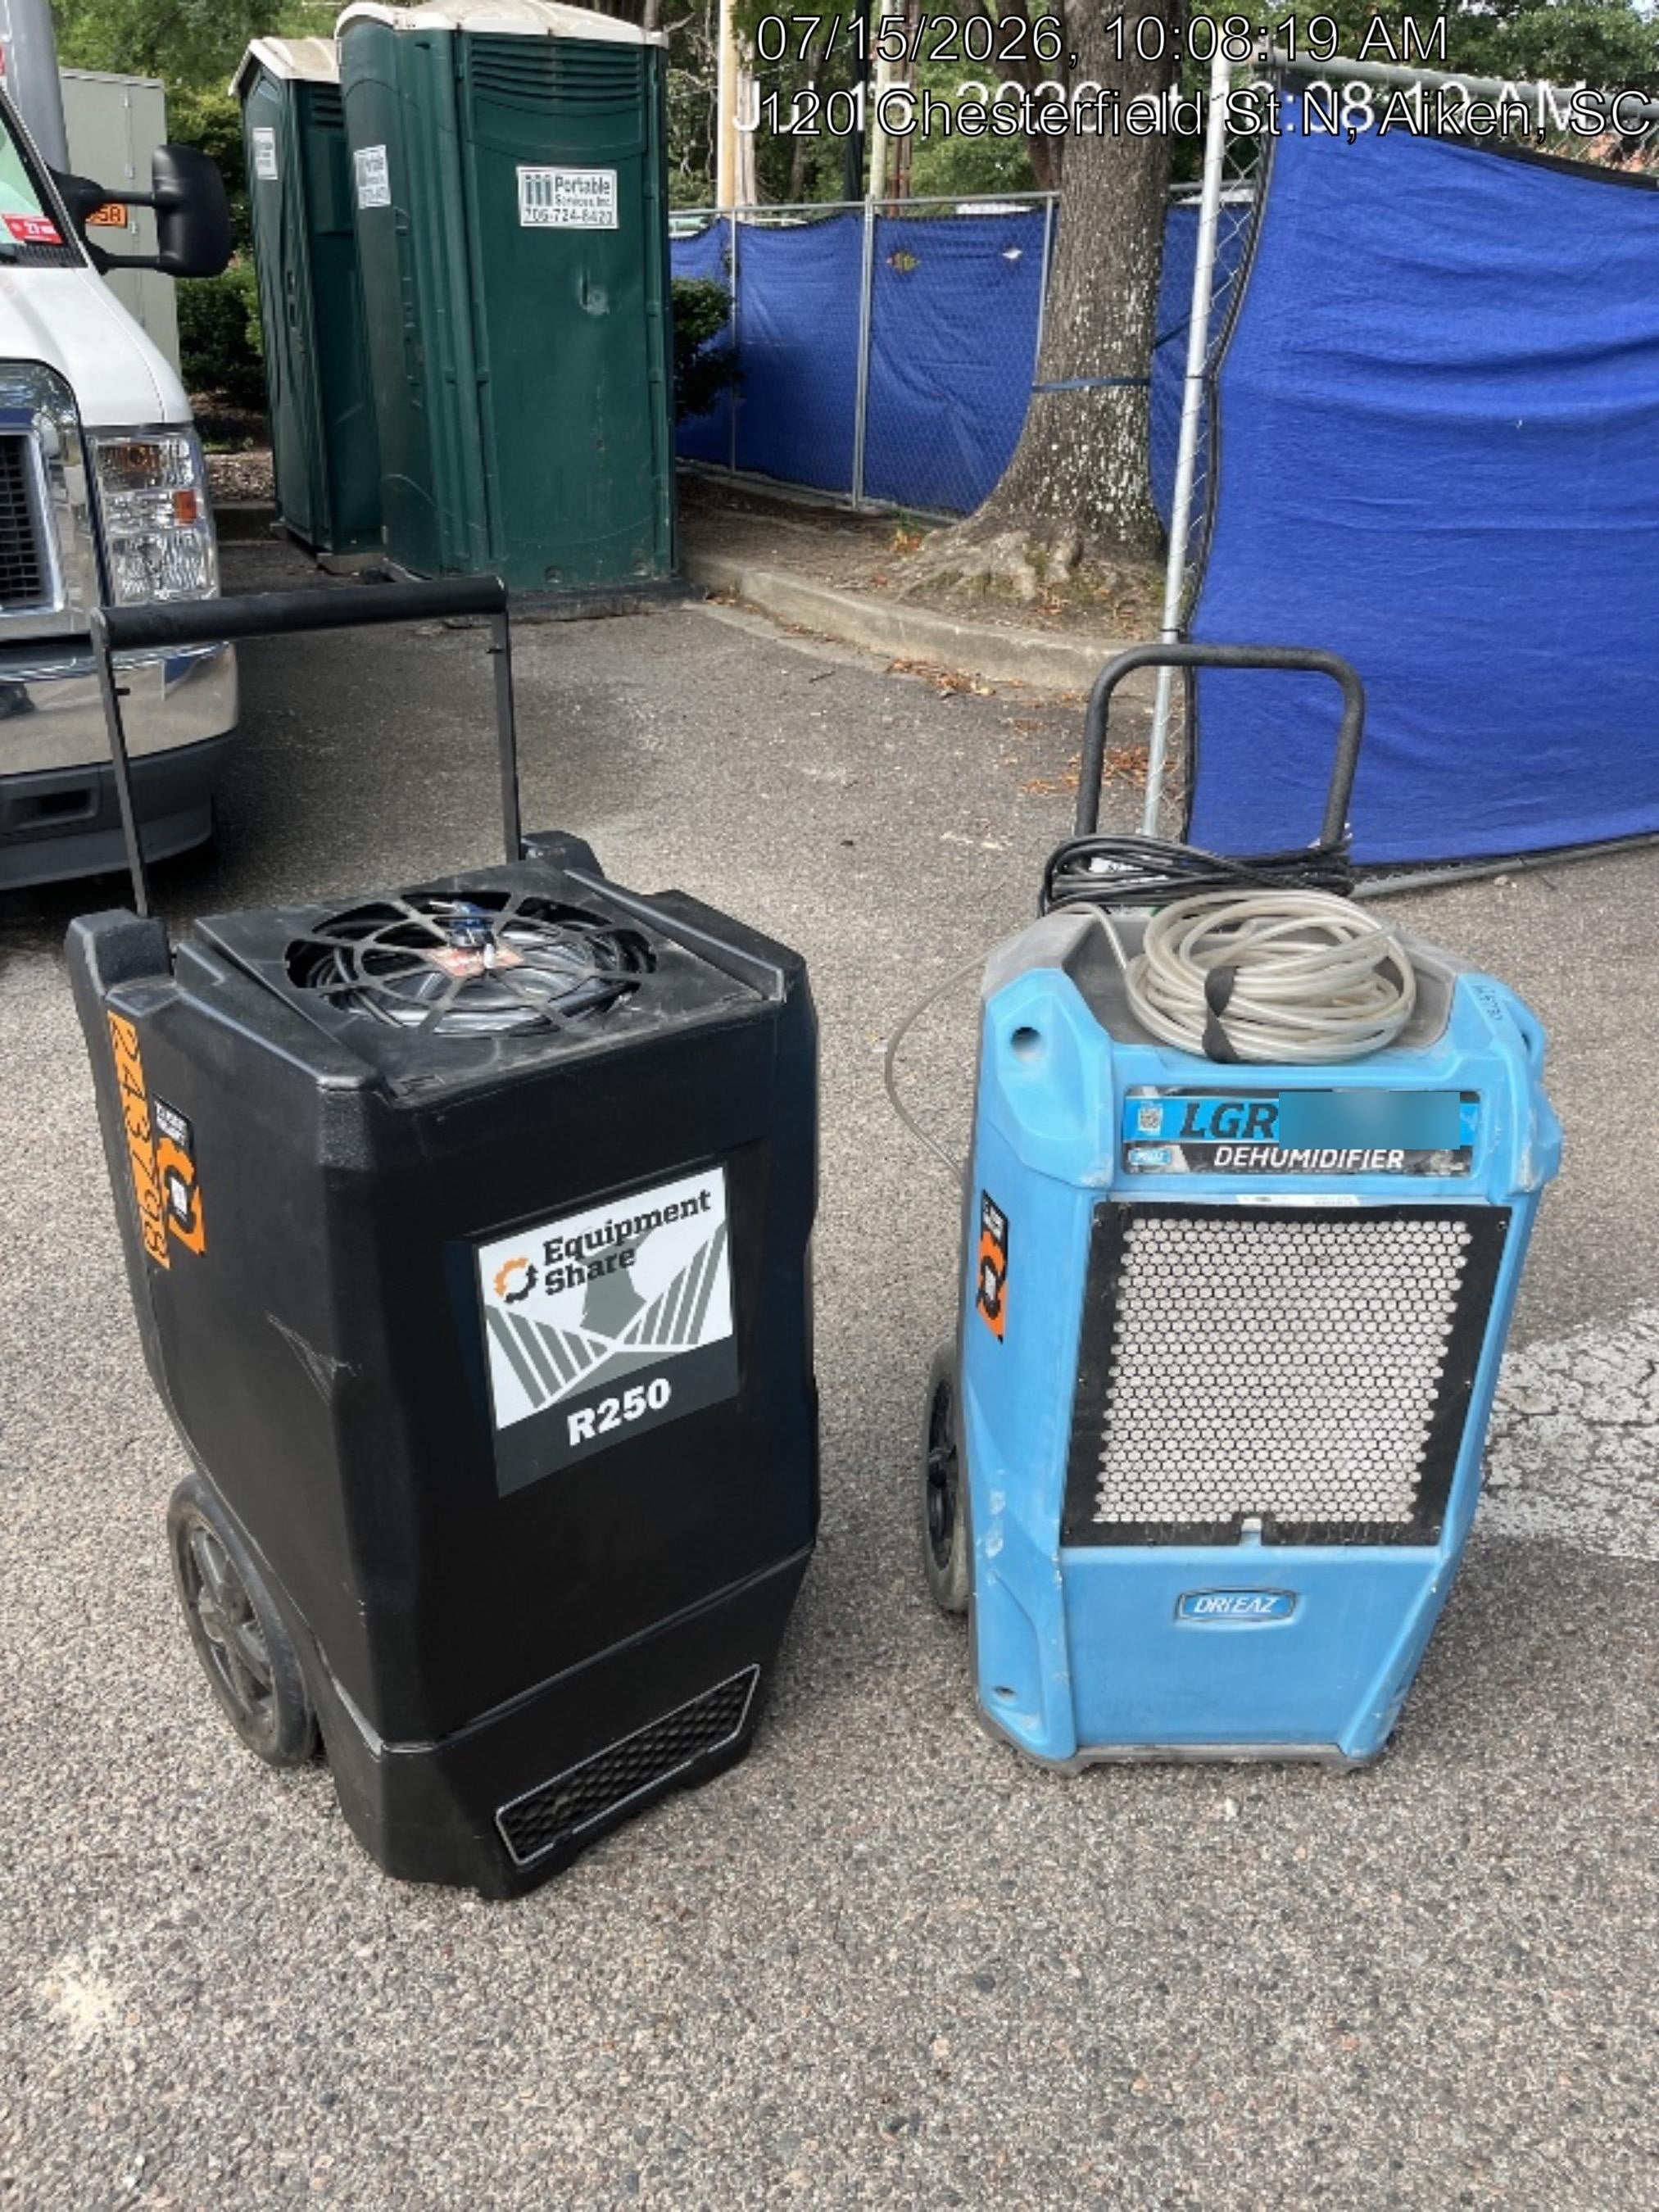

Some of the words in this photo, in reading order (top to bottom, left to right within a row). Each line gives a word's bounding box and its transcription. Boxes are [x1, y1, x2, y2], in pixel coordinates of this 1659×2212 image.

[555, 176, 610, 195] Portable
[1180, 1103, 1278, 1139] LGR
[1214, 1146, 1405, 1169] DEHUMIDIFIER
[542, 1189, 711, 1266] Equipment
[545, 1248, 636, 1295] Share
[567, 1378, 672, 1447] R250
